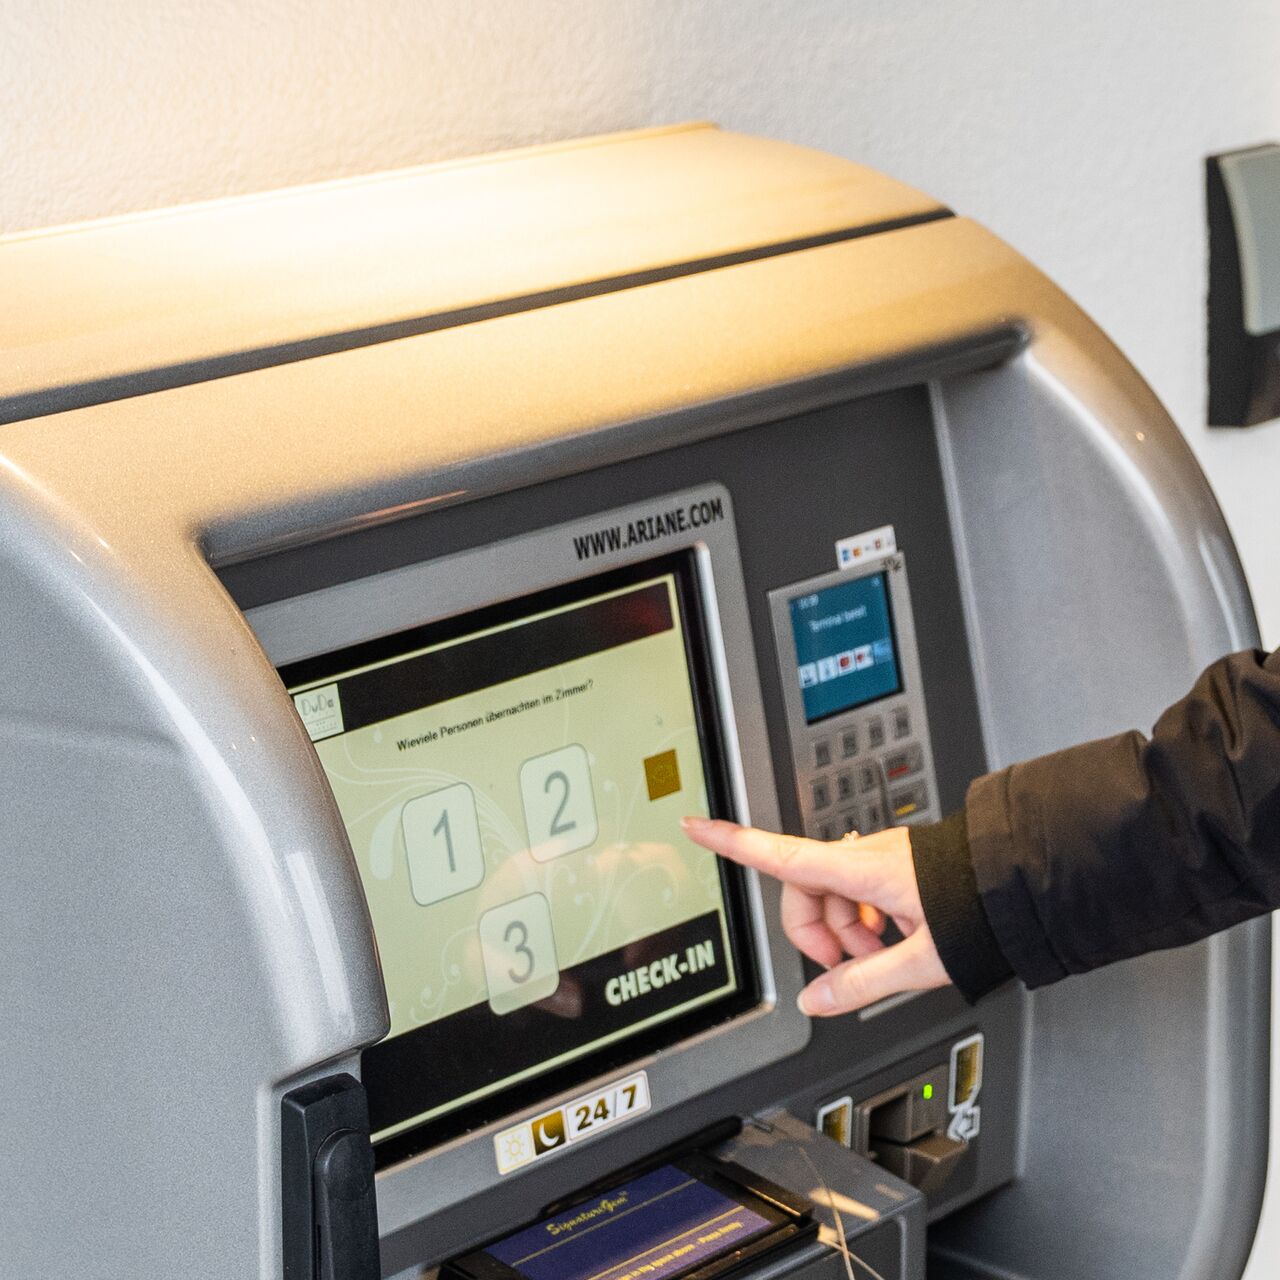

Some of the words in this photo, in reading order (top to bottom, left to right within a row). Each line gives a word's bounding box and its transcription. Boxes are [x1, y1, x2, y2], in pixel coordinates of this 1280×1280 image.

[573, 498, 724, 560] WWW.ARIANE.COM
[397, 732, 438, 752] Wieviele
[440, 717, 484, 737] Personen
[486, 698, 540, 724] übernachten
[542, 693, 553, 706] im
[555, 679, 594, 700] Zimmer?
[545, 770, 577, 837] 2
[433, 809, 456, 872] 1
[504, 921, 534, 984] 3
[605, 940, 716, 1006] CHECK-IN
[576, 1097, 609, 1131] 24
[622, 1084, 637, 1109] 7
